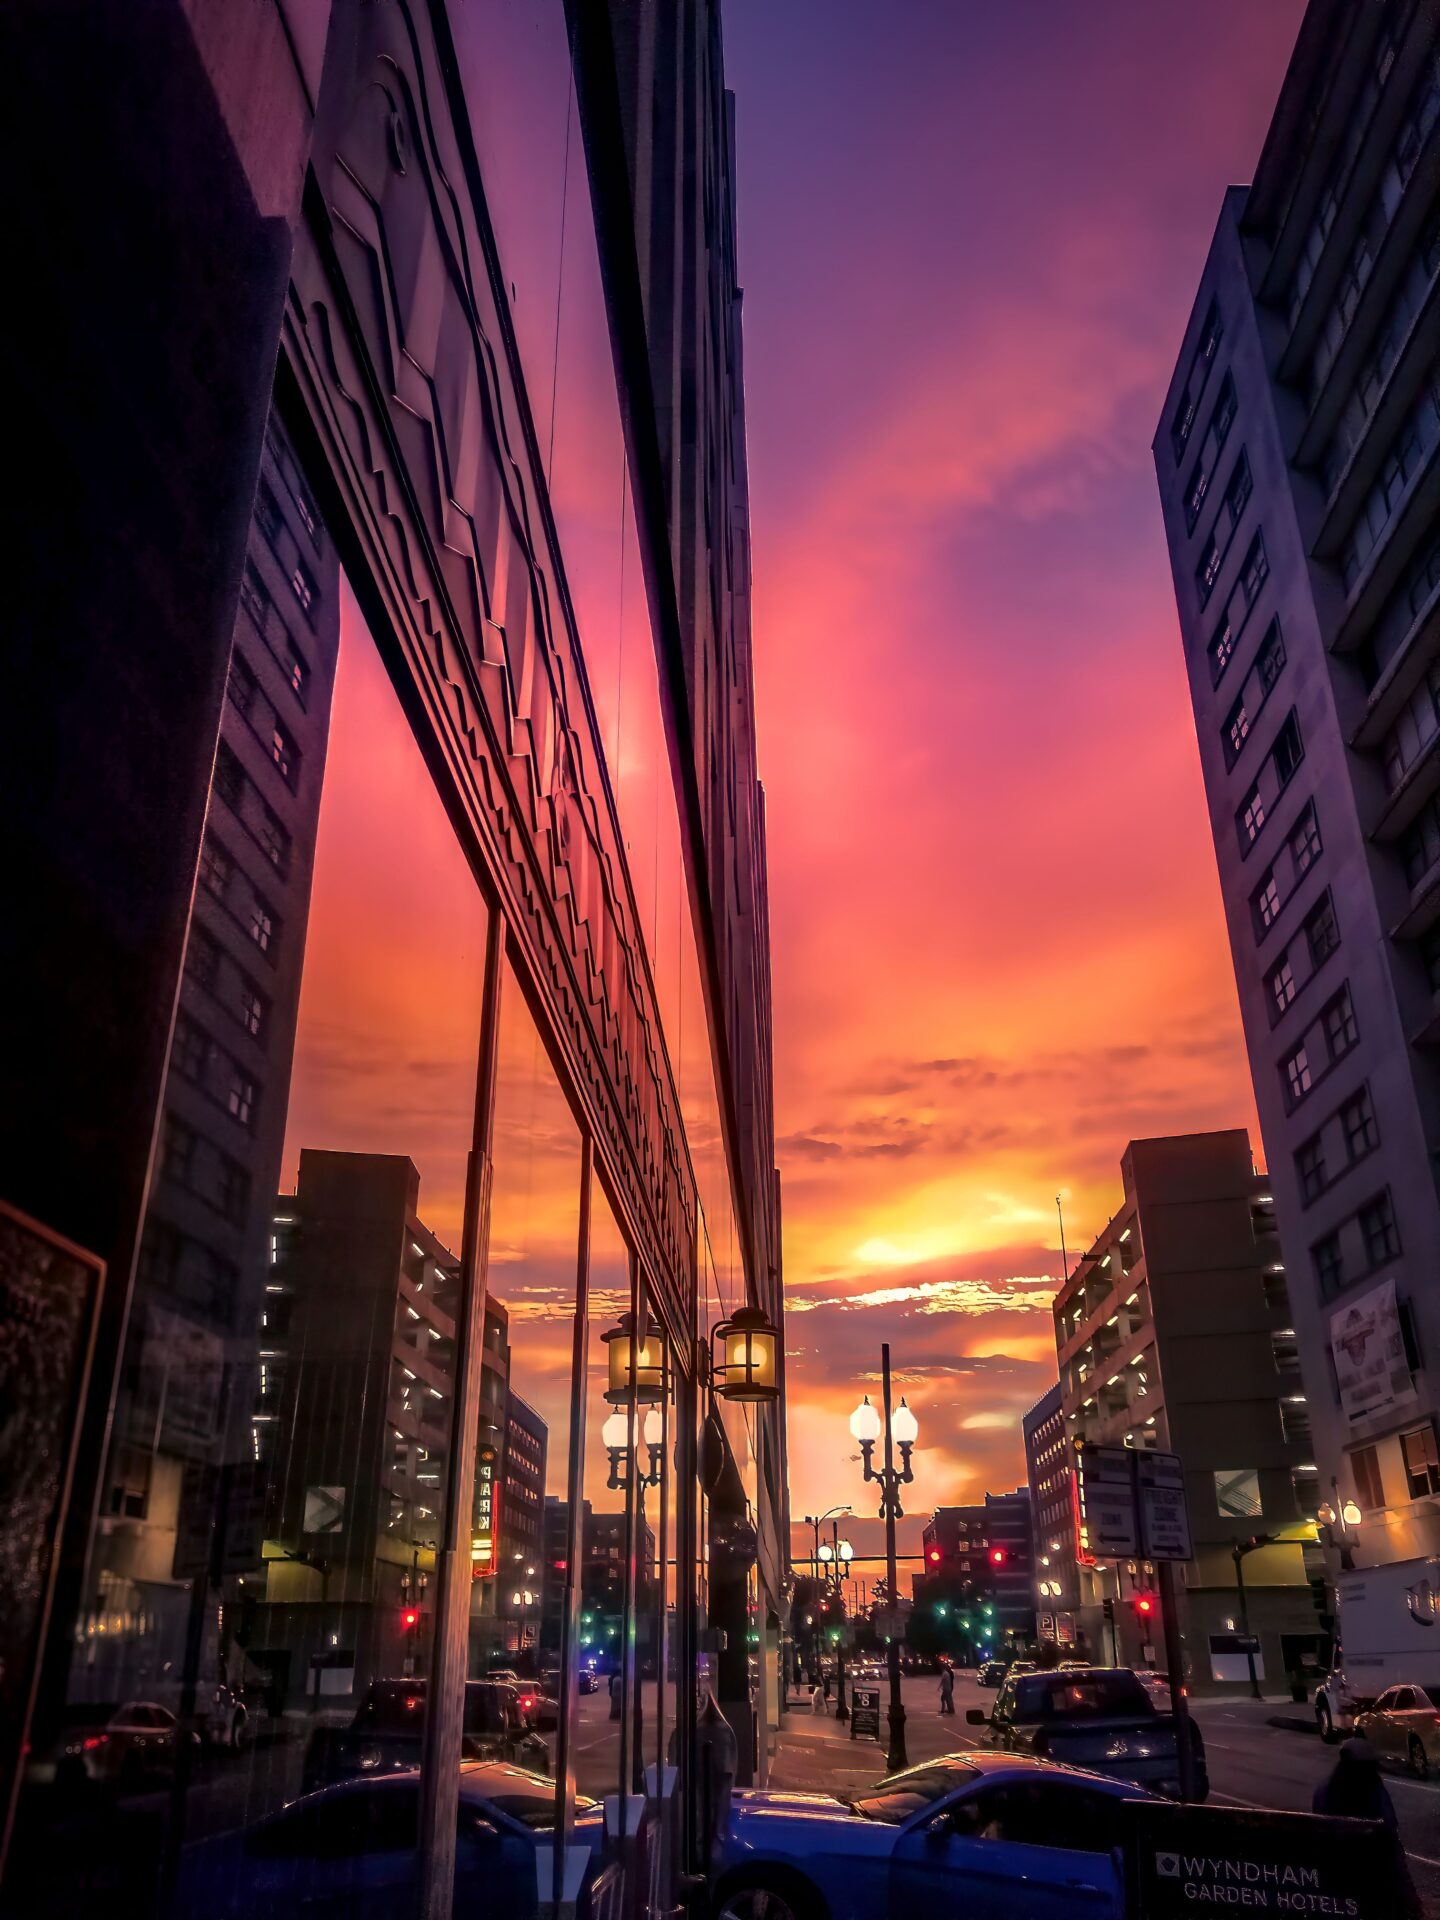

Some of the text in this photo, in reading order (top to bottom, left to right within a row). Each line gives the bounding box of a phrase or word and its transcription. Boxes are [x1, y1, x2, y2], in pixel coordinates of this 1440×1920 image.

[1184, 1856, 1319, 1888] WYNDHAM
[1184, 1882, 1359, 1916] GARDEN HOTELS
